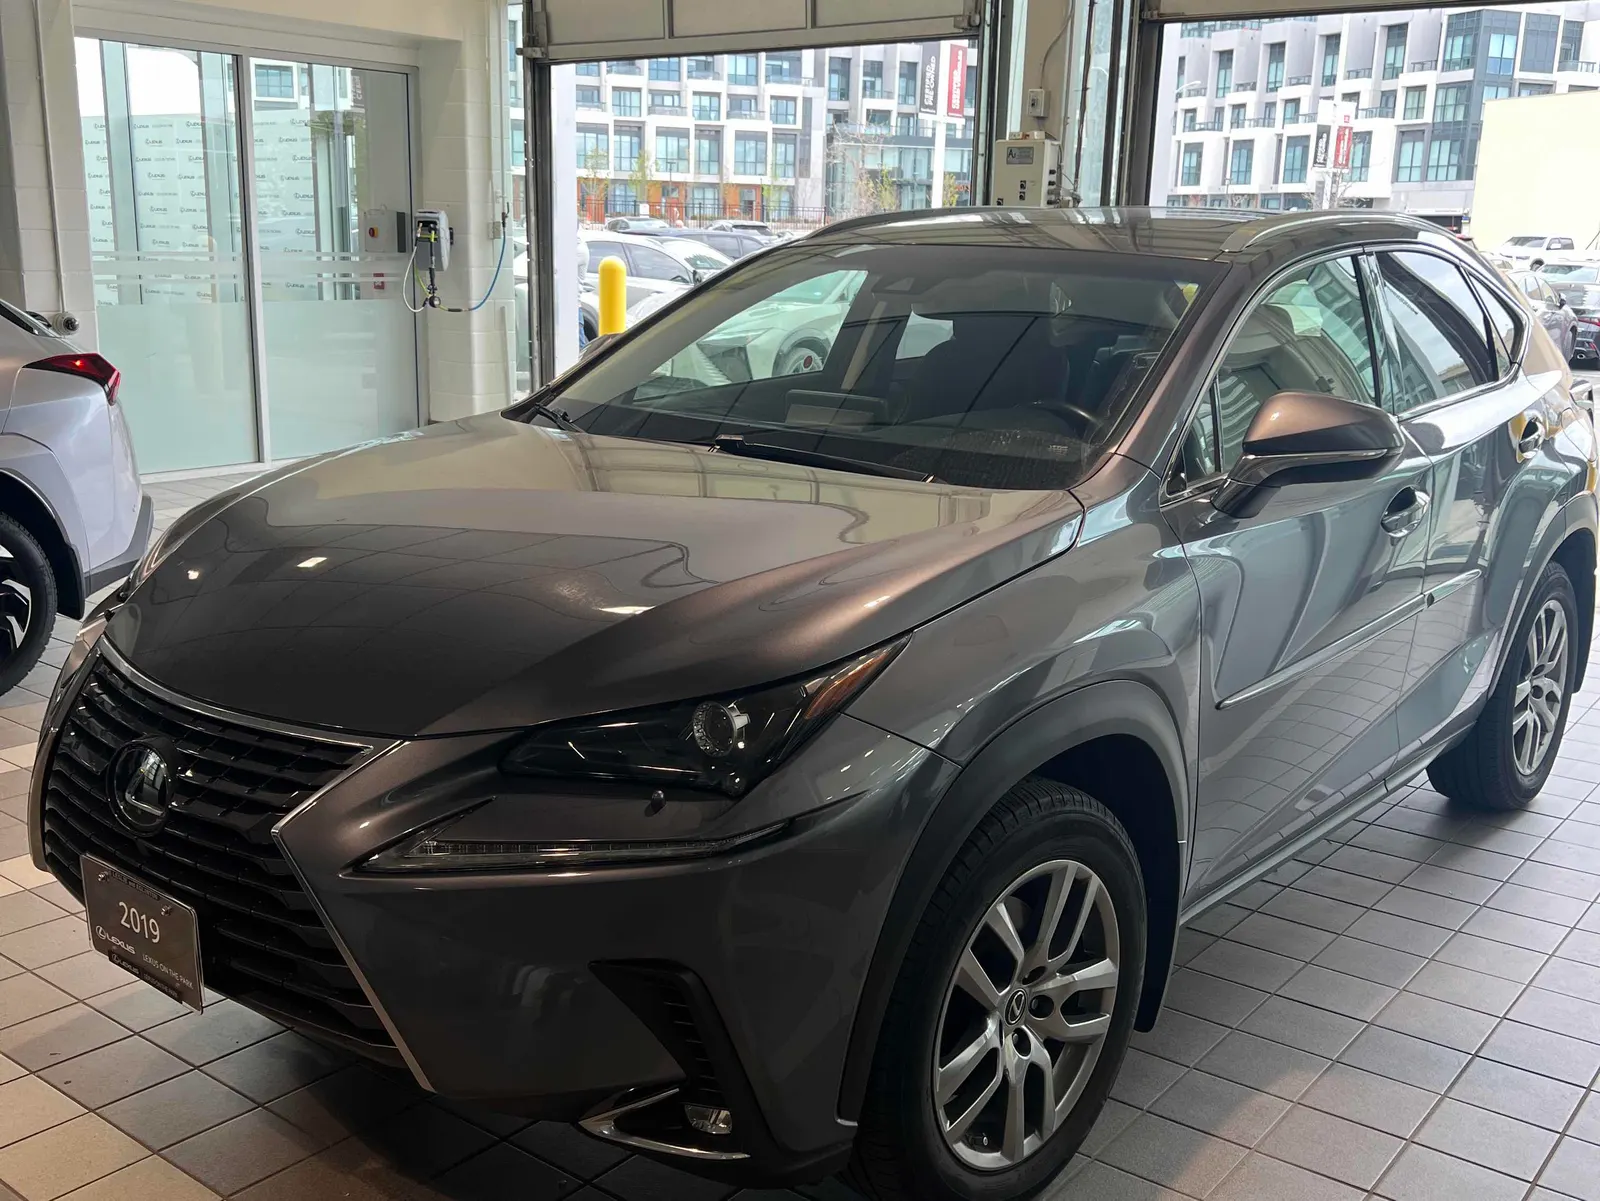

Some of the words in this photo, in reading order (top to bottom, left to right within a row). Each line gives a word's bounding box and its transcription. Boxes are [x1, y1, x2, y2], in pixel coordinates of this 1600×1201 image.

[118, 901, 160, 943] 2019
[106, 933, 136, 954] LEXUS
[142, 953, 159, 969] LEXUS
[159, 963, 169, 974] ON
[168, 968, 179, 981] THE
